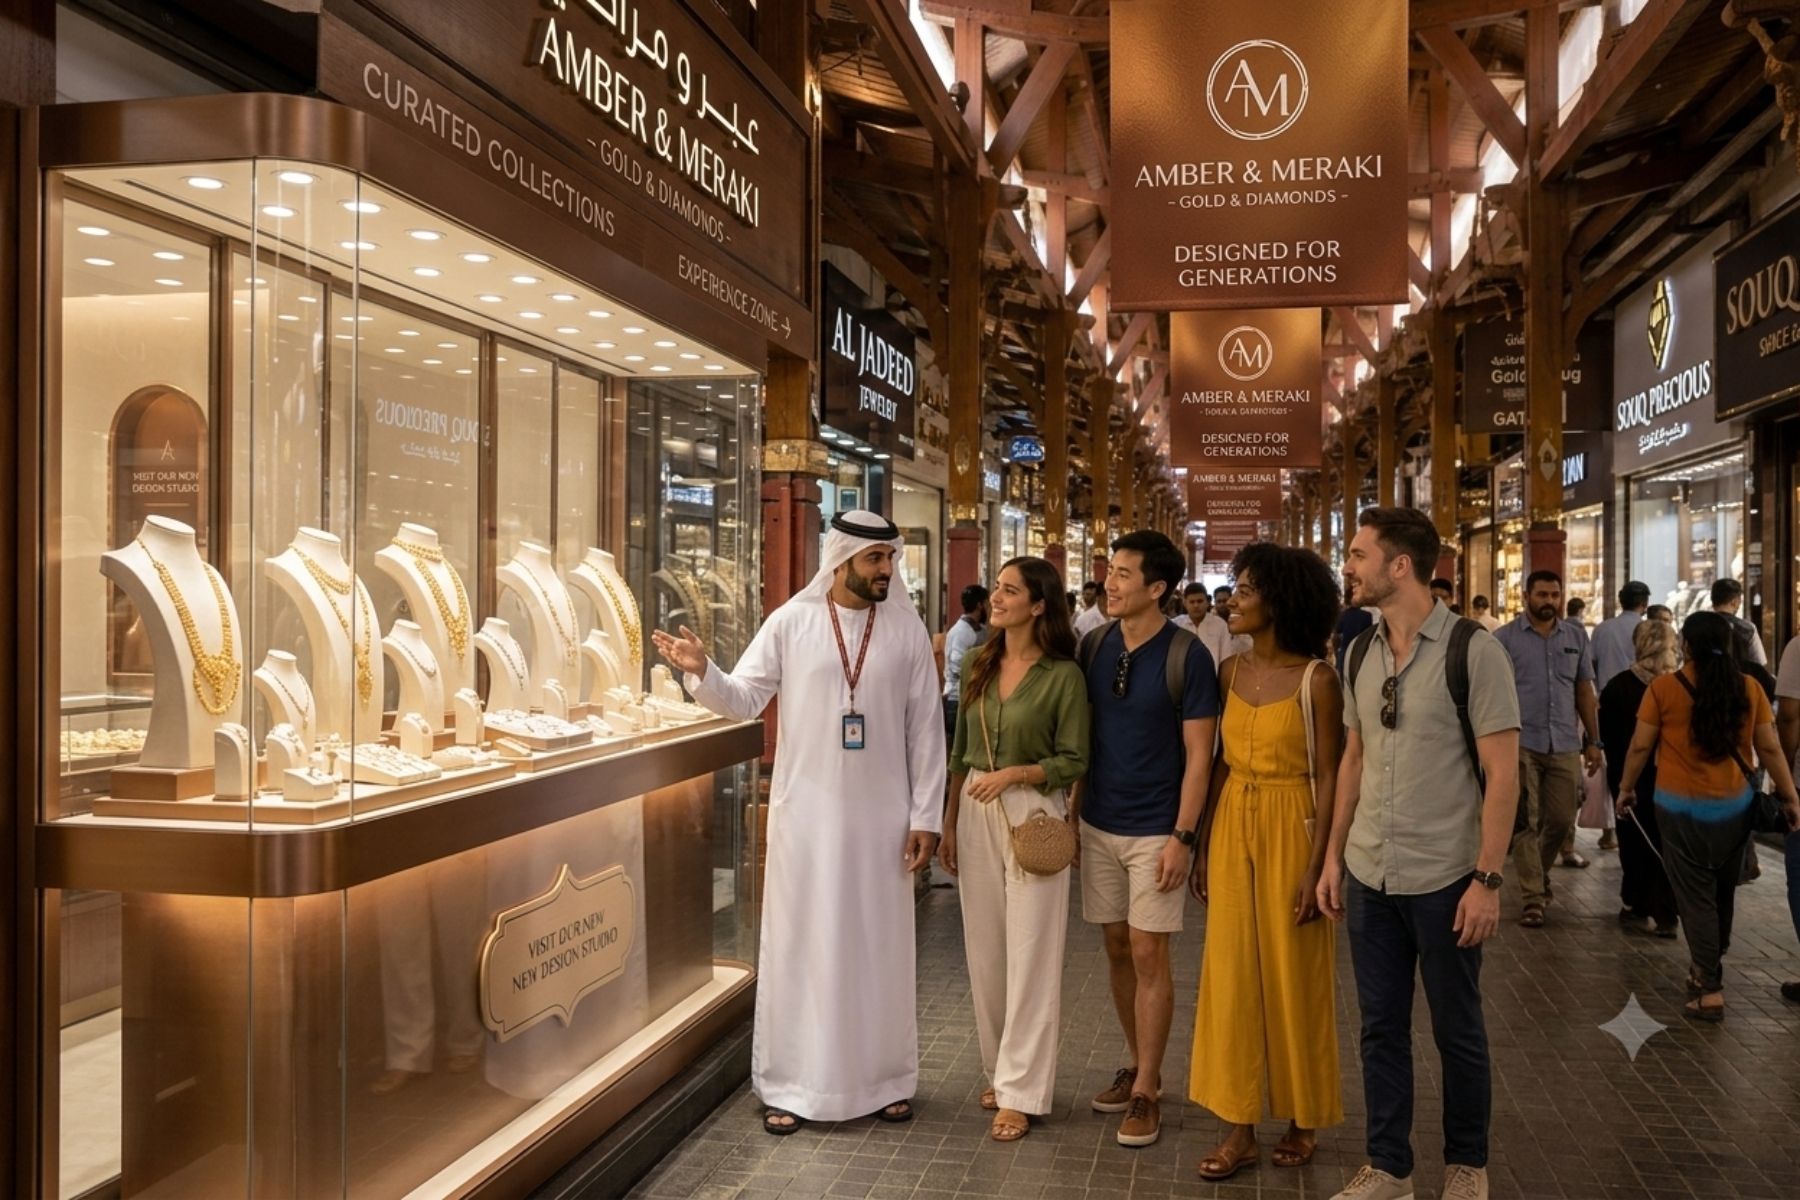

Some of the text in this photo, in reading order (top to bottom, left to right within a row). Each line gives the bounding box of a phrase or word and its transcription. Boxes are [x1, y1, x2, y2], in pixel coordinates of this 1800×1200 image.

[539, 17, 760, 228] AMBER & MERAKI
[363, 62, 615, 237] CURATED COLLECTIONS
[1134, 155, 1382, 188] AMBER & MERAKI
[600, 140, 725, 244] GOLD & DIAMONDS
[1179, 190, 1337, 209] GOLD & DIAMONDS
[1174, 240, 1341, 263] DESIGNED FOR
[1178, 264, 1337, 287] GENERATIONS
[1727, 255, 1800, 336] SOUQ
[750, 297, 778, 332] ZONE
[832, 307, 914, 397] AL JADEED
[1181, 391, 1234, 404] AMBER
[1252, 390, 1310, 403] MERAKI
[1617, 360, 1710, 431] SOUQ PRECIOUS
[1493, 411, 1526, 426] GAT
[1202, 432, 1289, 444] DESIGNED FOR
[1203, 445, 1288, 457] GENERATIONS
[528, 932, 556, 959] VISIT
[512, 966, 537, 994] NEW
